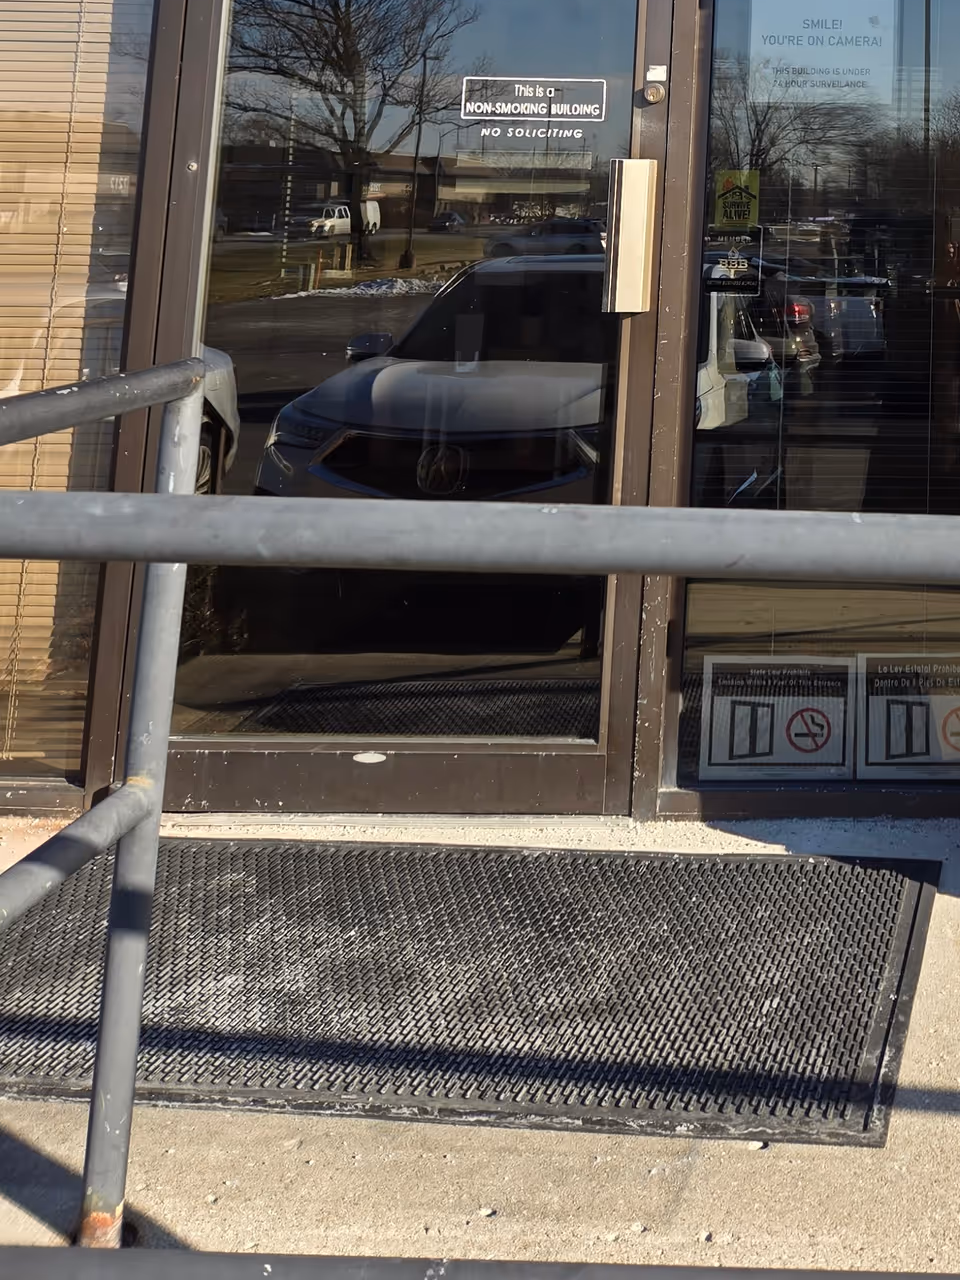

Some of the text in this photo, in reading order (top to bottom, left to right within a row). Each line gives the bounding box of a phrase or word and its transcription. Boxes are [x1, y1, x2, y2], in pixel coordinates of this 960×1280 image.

[802, 18, 843, 30] SMILE!
[761, 35, 882, 47] YOU'RE ON CAMERA!
[791, 67, 830, 75] BUILDING
[514, 84, 555, 98] This is a
[465, 102, 600, 116] NON-SMOKING BUILDING
[480, 128, 584, 139] NO SOLICITING
[722, 209, 751, 220] ALIVE!
[718, 258, 748, 269] BBB
[905, 664, 931, 673] Estatal
